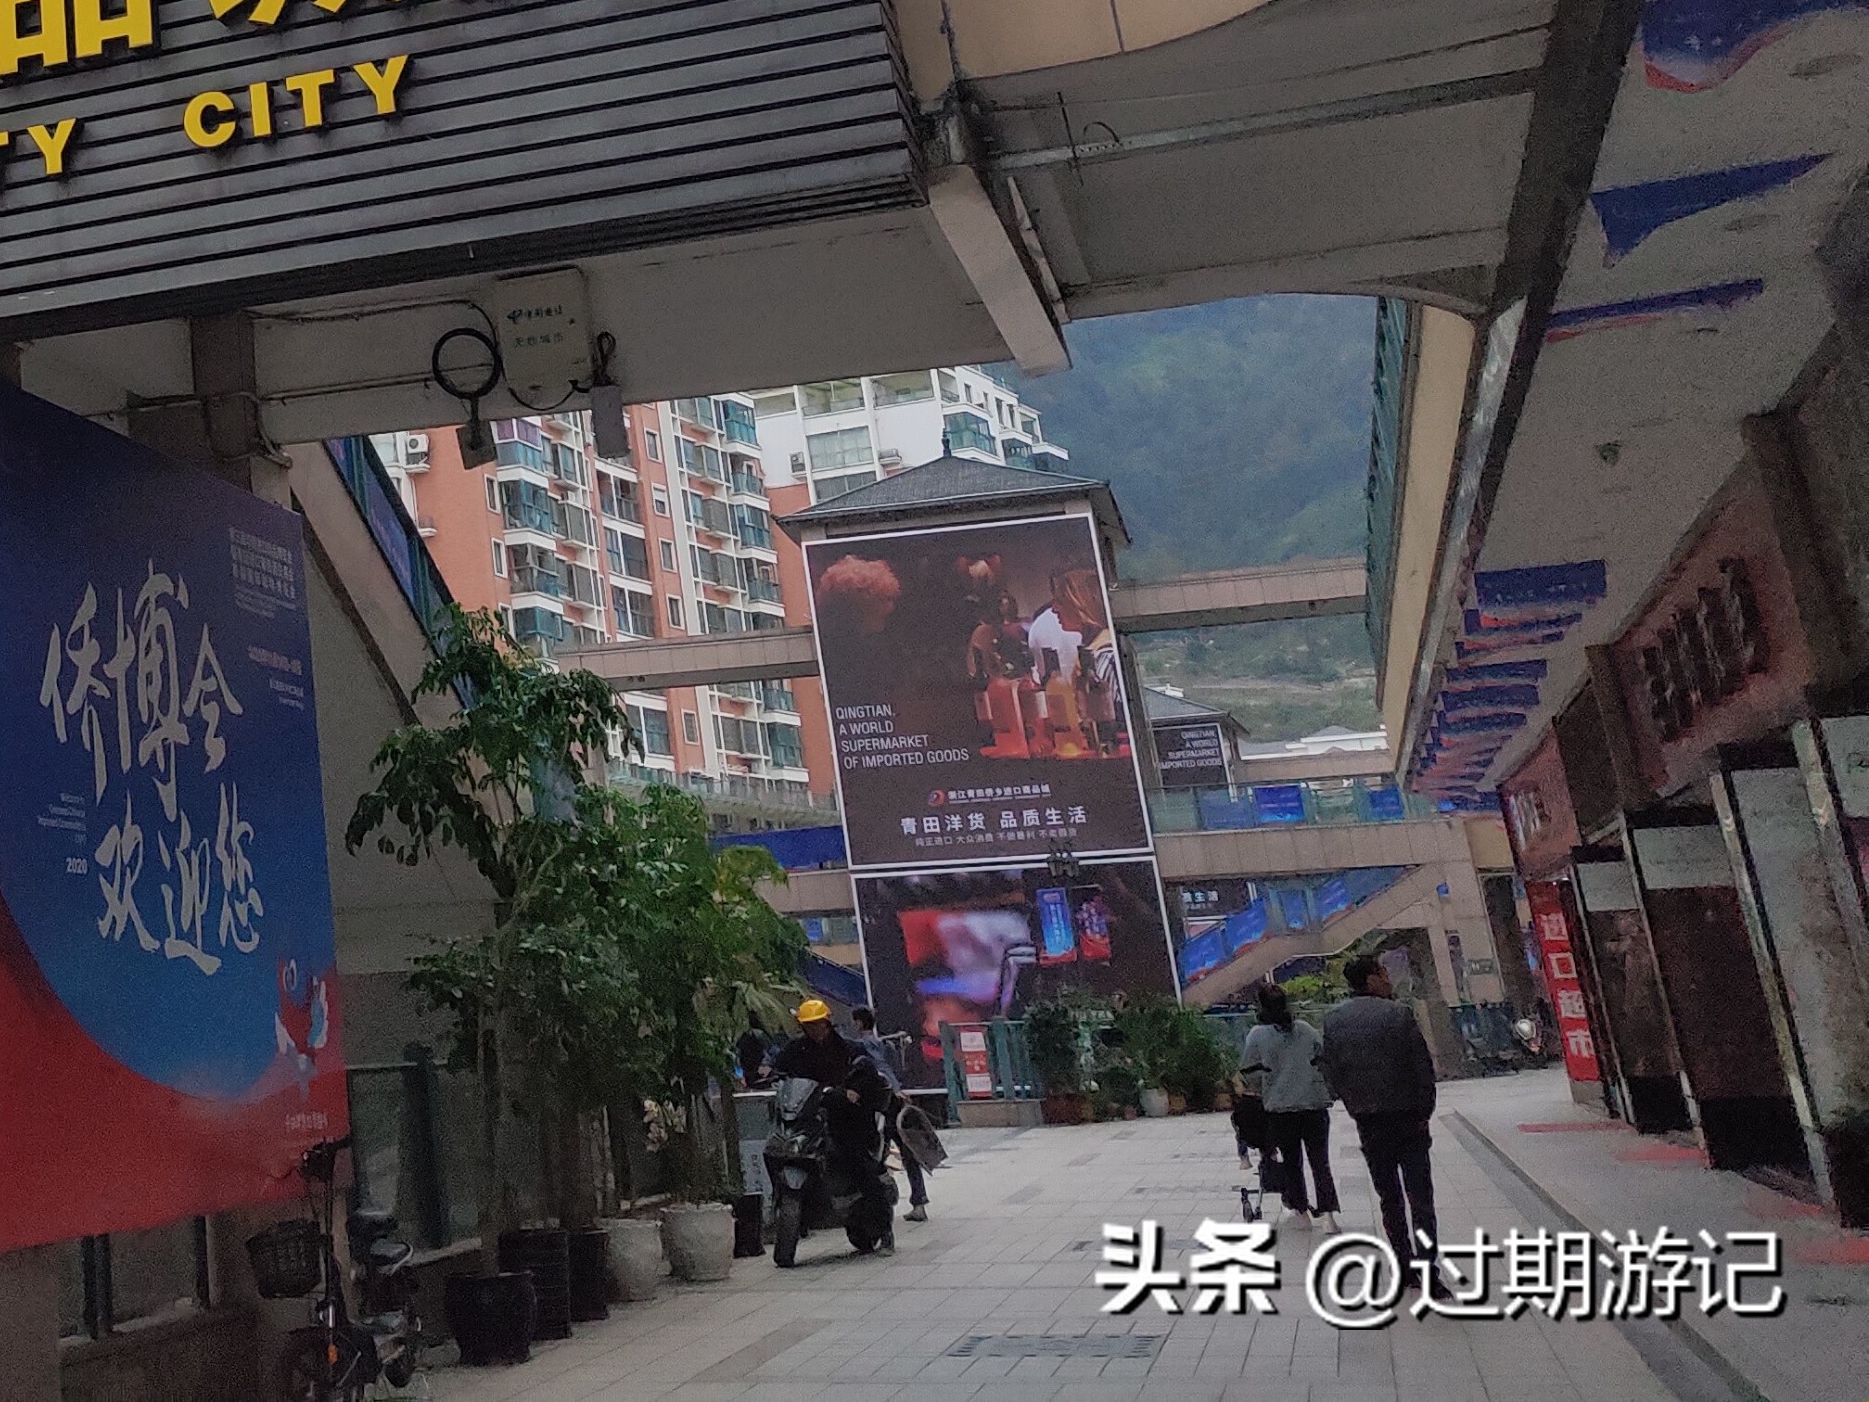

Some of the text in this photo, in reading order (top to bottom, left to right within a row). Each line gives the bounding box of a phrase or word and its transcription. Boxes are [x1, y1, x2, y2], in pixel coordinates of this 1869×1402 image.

[182, 54, 409, 150] CITY
[839, 721, 894, 735] A WORLD
[841, 734, 930, 753] SUPERMARKET
[844, 747, 970, 770] OF IMPORTED GOODS
[900, 805, 1087, 836] 青田洋货 品质生活
